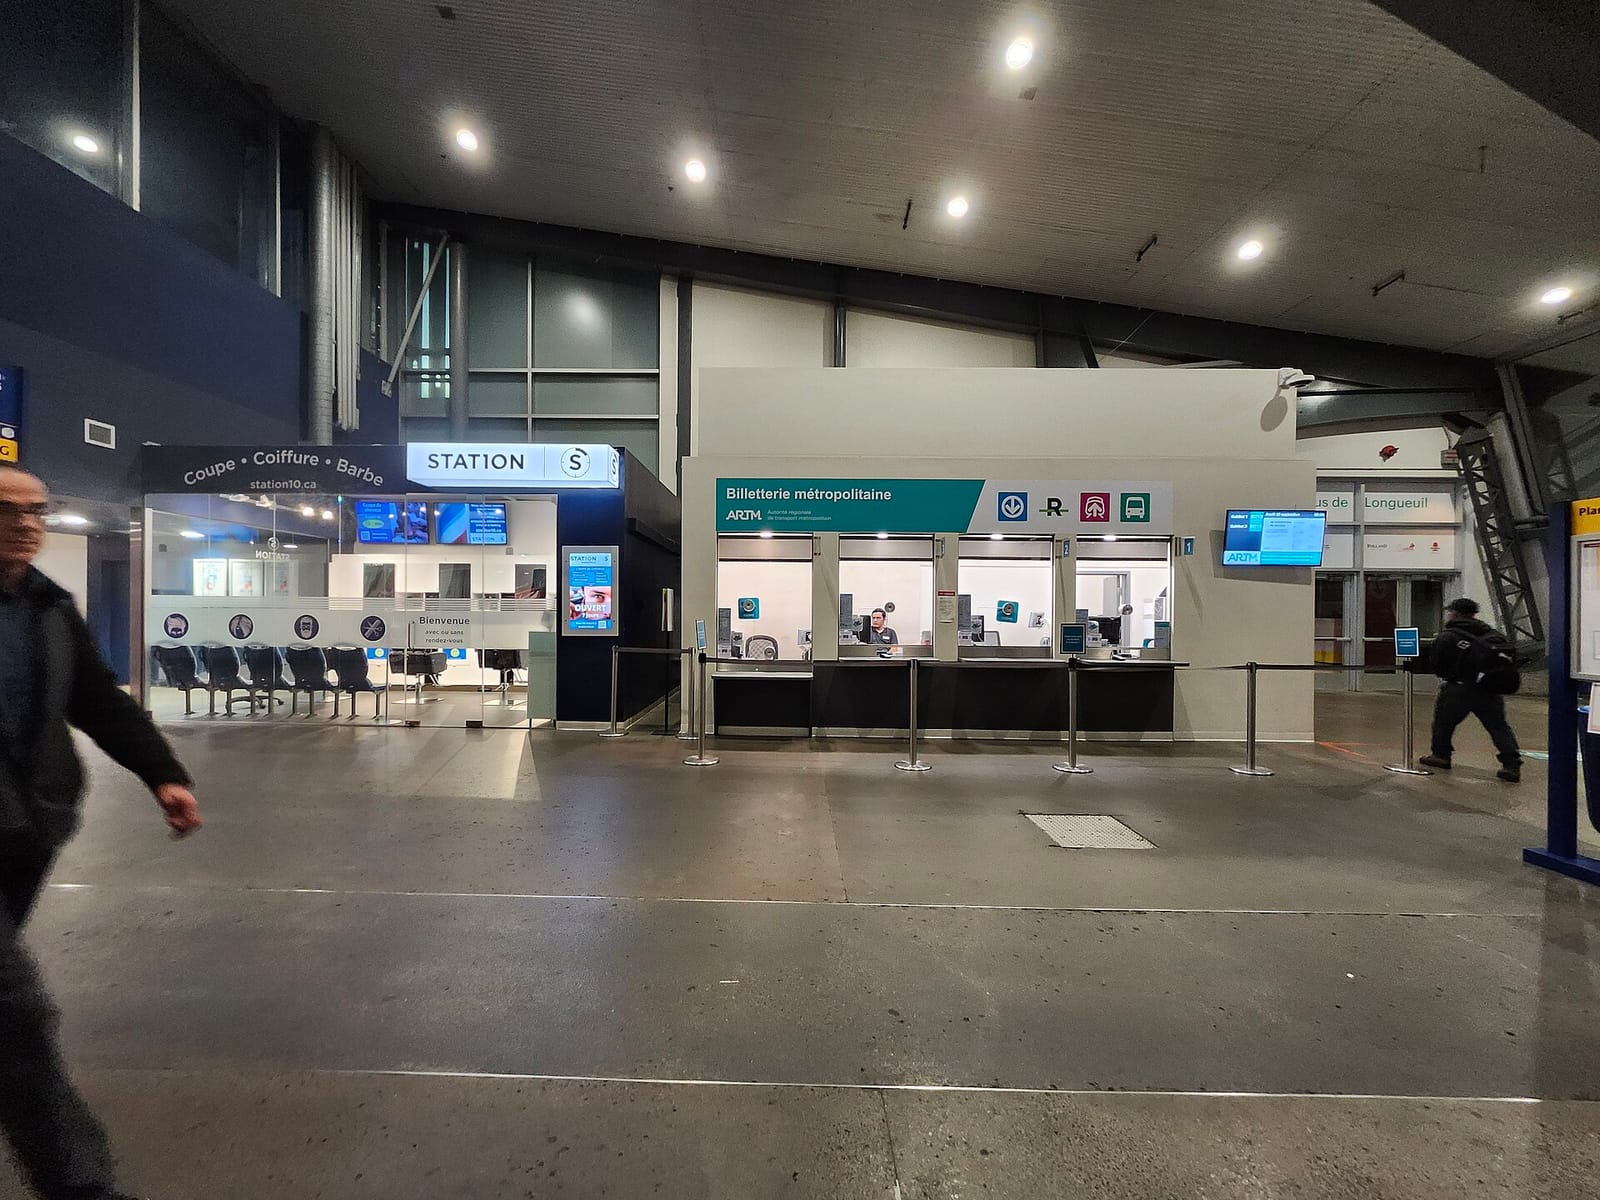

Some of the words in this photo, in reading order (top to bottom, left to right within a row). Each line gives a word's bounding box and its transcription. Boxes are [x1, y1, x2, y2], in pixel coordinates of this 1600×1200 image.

[183, 458, 236, 485] Coupe
[253, 450, 319, 466] Coiffure
[336, 458, 384, 487] Barbe
[250, 479, 317, 489] station10.ca
[726, 487, 790, 499] Billetterie
[794, 488, 892, 502] métropolitaine
[1047, 497, 1063, 517] R
[1332, 497, 1348, 508] de
[1364, 497, 1428, 510] Longueuil
[726, 510, 762, 520] ARTM
[1063, 543, 1069, 555] 2
[1227, 553, 1258, 562] ARTM
[575, 604, 606, 612] OUVERT
[419, 616, 470, 624] Bienvenue
